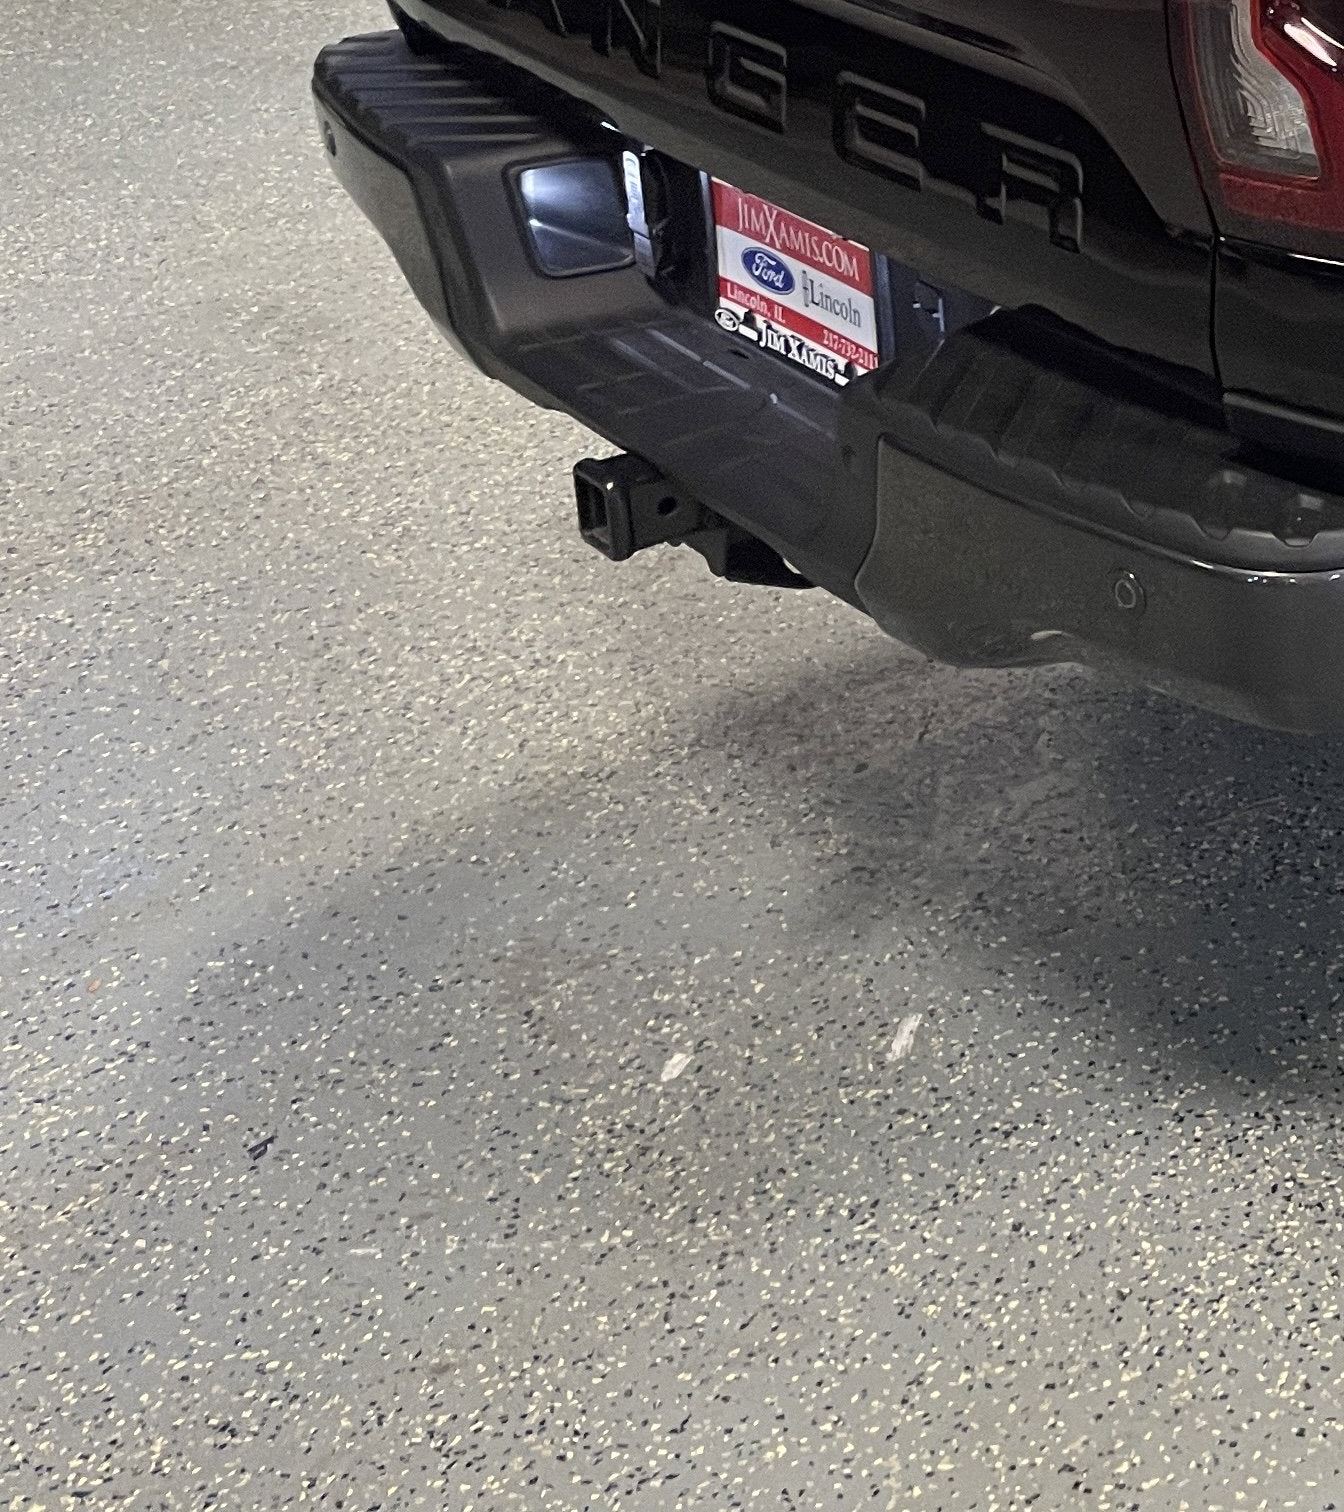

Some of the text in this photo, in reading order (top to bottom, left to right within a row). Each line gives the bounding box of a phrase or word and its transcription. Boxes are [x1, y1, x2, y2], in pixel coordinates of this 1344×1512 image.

[751, 252, 785, 289] Ford
[809, 278, 861, 328] Lincoln
[759, 323, 836, 380] JIM XAMIS
